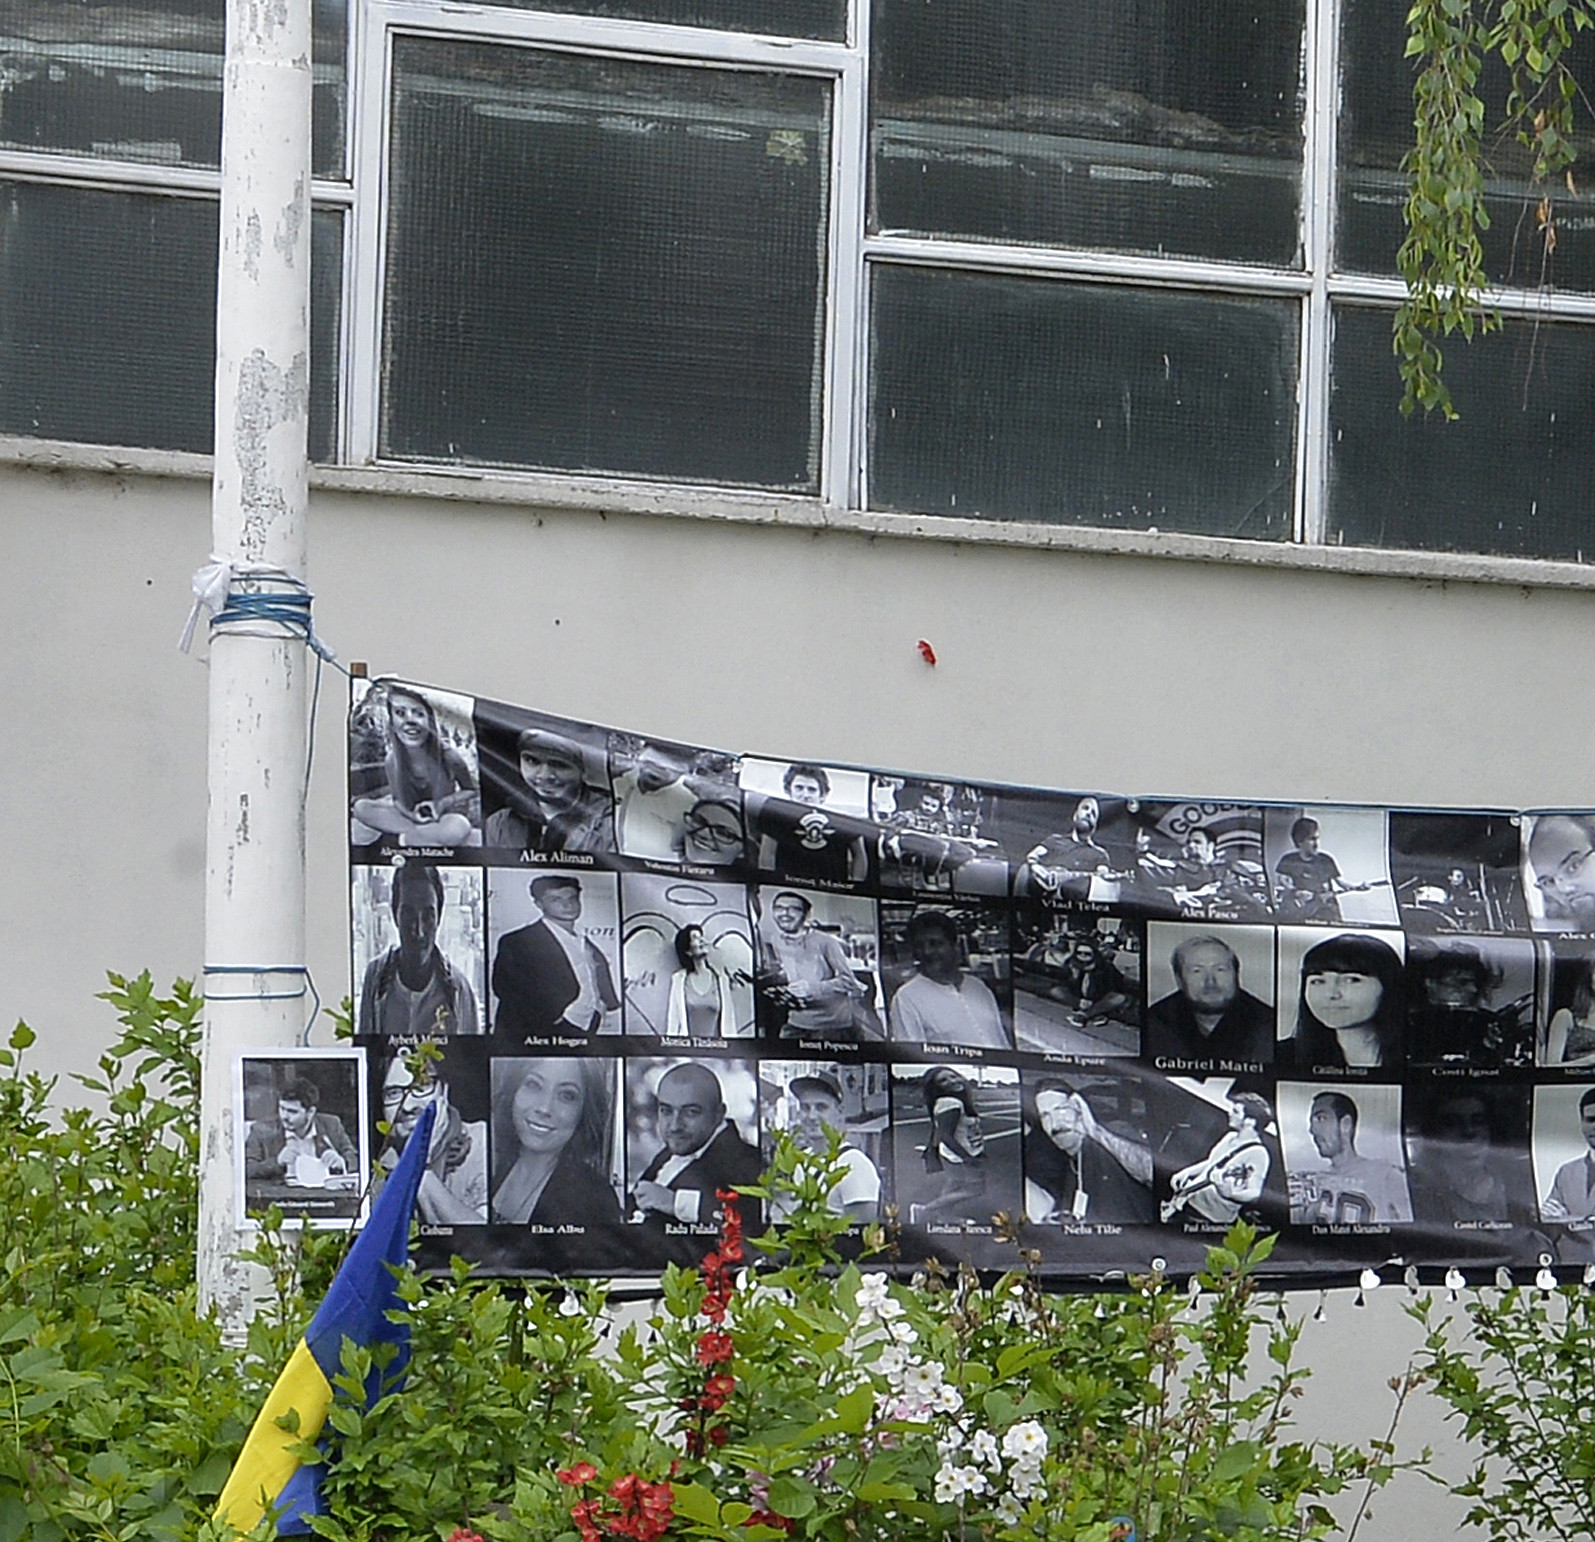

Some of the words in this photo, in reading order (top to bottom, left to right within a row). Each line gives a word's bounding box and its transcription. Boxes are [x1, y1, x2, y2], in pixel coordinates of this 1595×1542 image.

[519, 848, 548, 863] Alex
[551, 850, 594, 865] Aliman
[1181, 907, 1206, 919] Alex
[1208, 906, 1239, 919] Pascu
[1558, 931, 1587, 940] Alex
[524, 1035, 549, 1045] Alex
[927, 1042, 950, 1053] Ioan
[952, 1045, 983, 1057] Tripa
[1154, 1056, 1214, 1070] Gabriel
[1219, 1059, 1265, 1074] Matei
